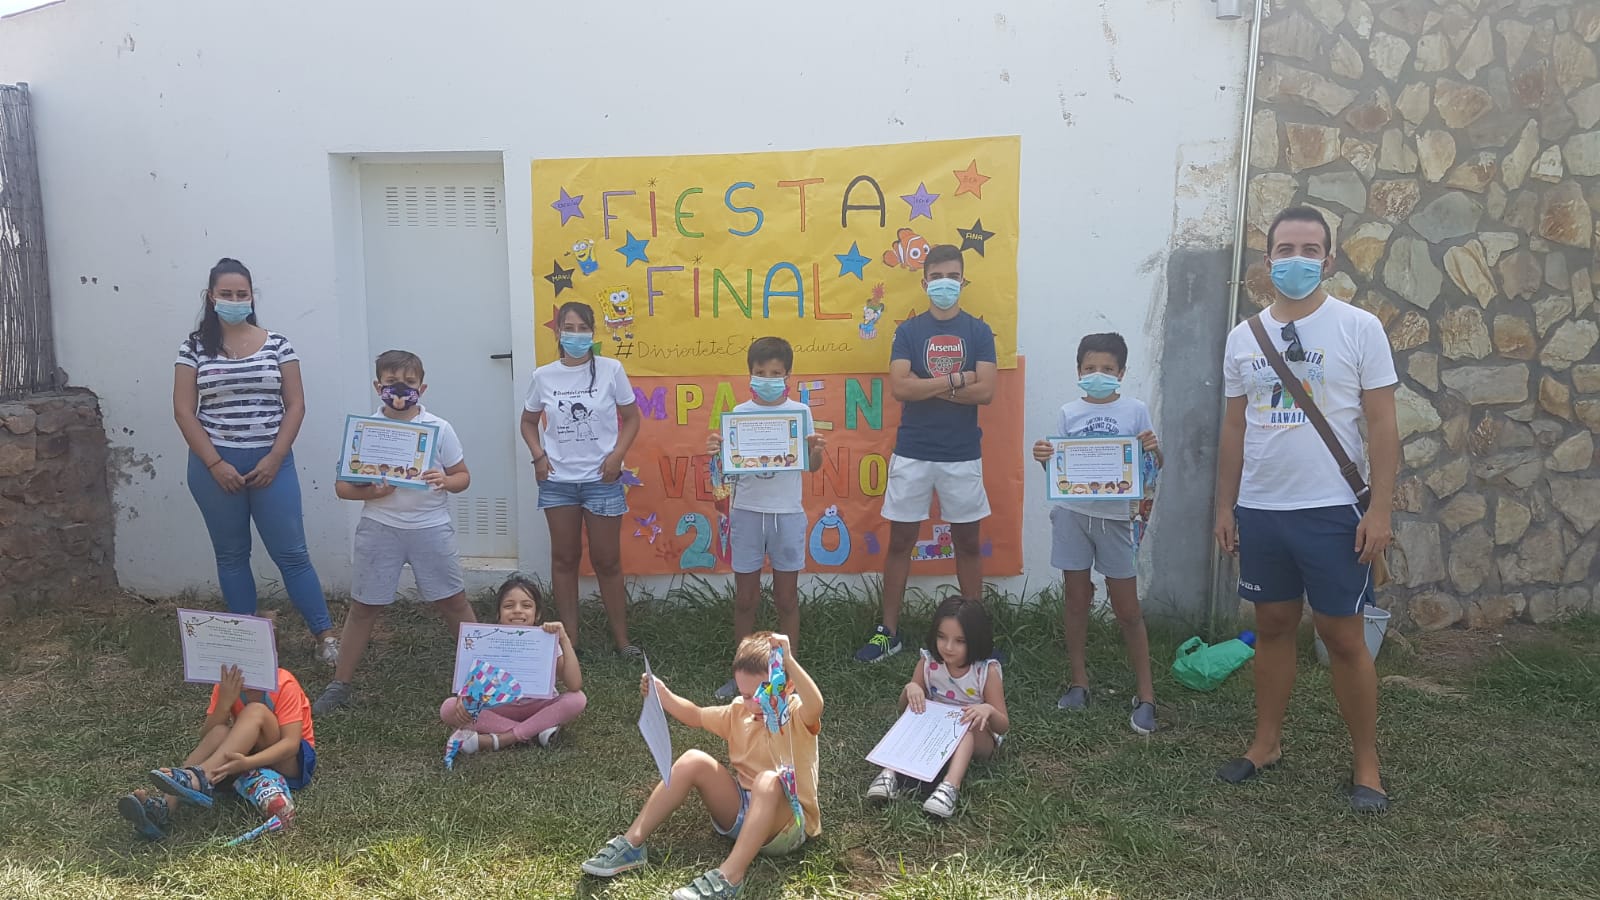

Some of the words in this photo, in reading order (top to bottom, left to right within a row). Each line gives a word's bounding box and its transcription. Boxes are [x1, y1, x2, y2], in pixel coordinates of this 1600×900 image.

[965, 232, 983, 241] ANA
[929, 343, 961, 352] Arsenal
[658, 447, 889, 501] VENO
